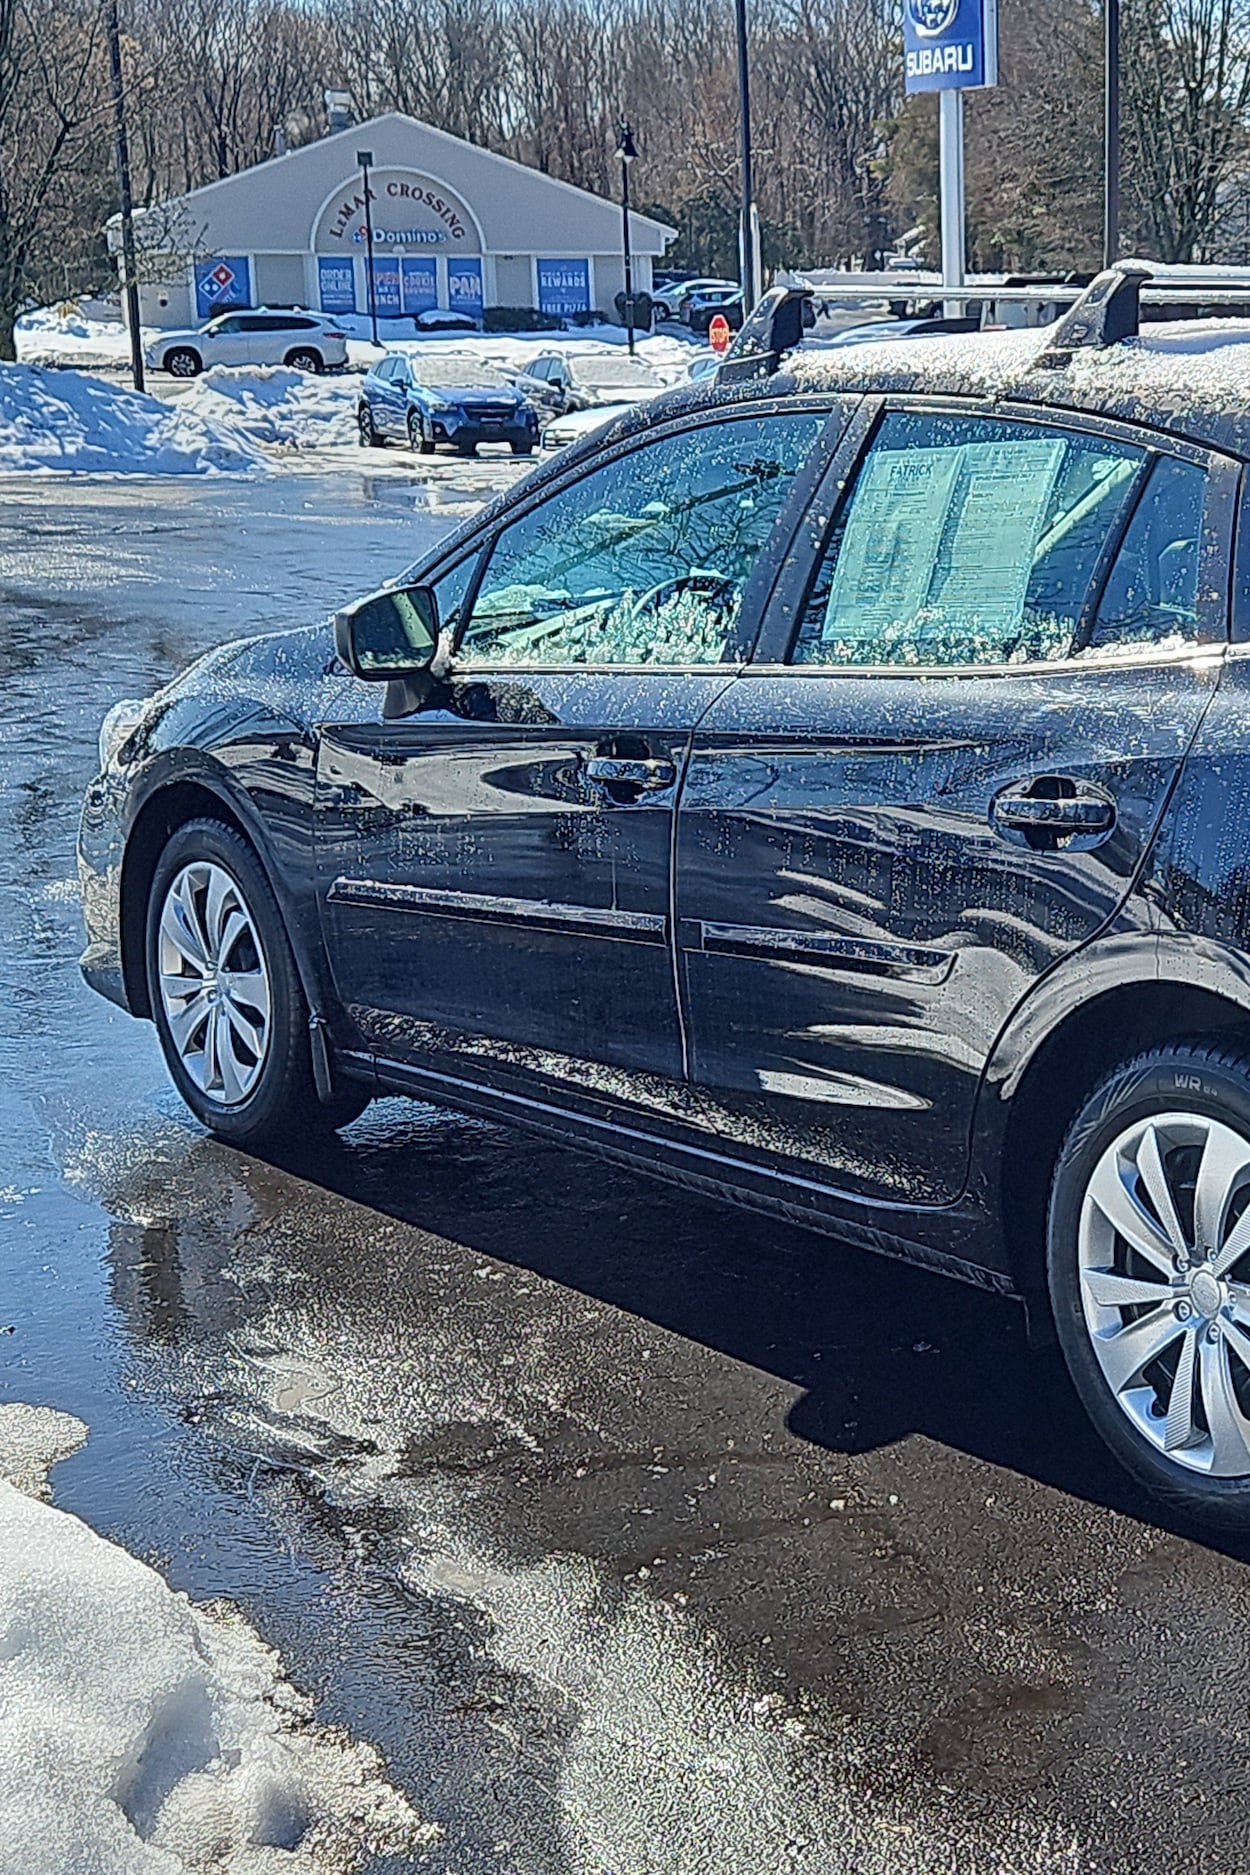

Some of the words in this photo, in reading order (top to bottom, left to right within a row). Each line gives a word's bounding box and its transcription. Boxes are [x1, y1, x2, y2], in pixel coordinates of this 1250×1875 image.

[906, 44, 973, 77] SUBARU
[387, 183, 465, 239] CROSSING
[373, 228, 447, 243] Domino's
[321, 268, 352, 280] ORDER
[541, 276, 586, 287] REWARDS
[321, 280, 353, 292] ONLINE
[450, 276, 481, 297] PAN
[711, 327, 728, 343] STOP
[1174, 1073, 1201, 1092] WR
